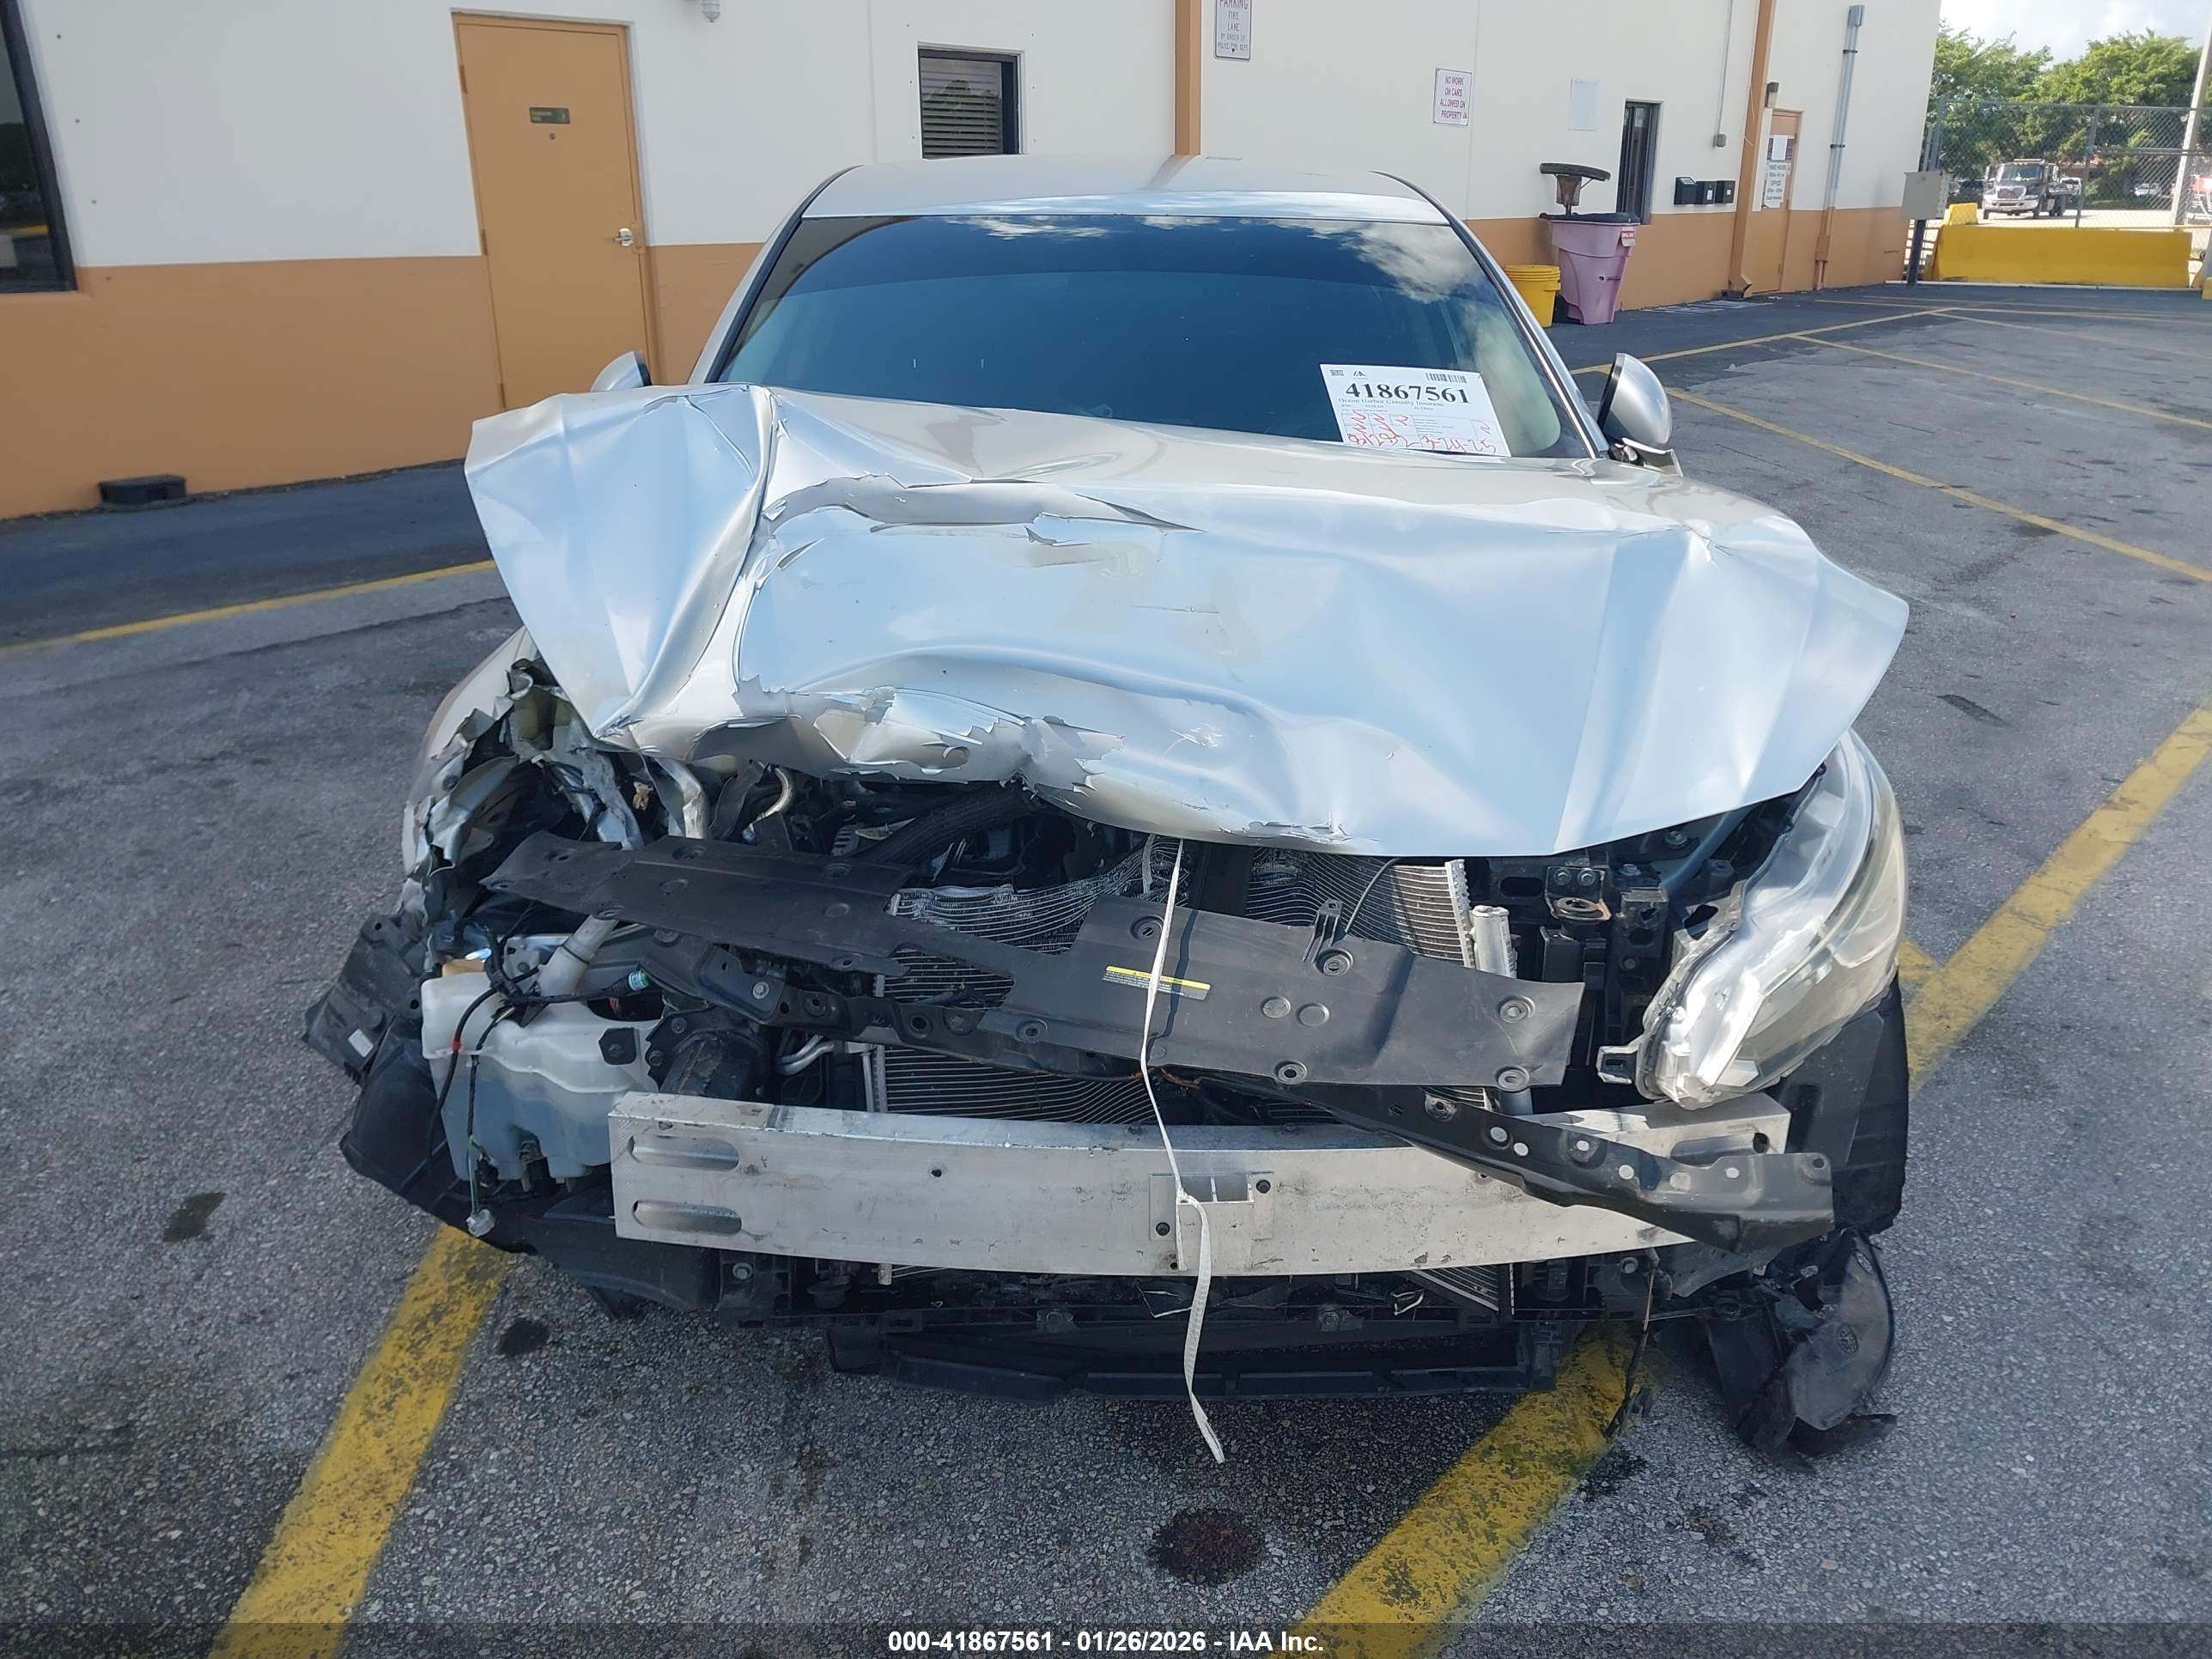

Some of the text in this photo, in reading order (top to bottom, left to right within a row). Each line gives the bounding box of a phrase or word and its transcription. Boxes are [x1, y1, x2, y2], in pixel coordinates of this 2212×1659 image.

[1228, 10, 1239, 21] FIRE
[1228, 22, 1239, 32] LANE
[1444, 76, 1464, 86] NO WORK
[1444, 88, 1463, 97] ON CARS
[1439, 98, 1459, 108] ALLOWED
[1441, 110, 1462, 119] PROPERTY
[1346, 383, 1470, 404] 41867561
